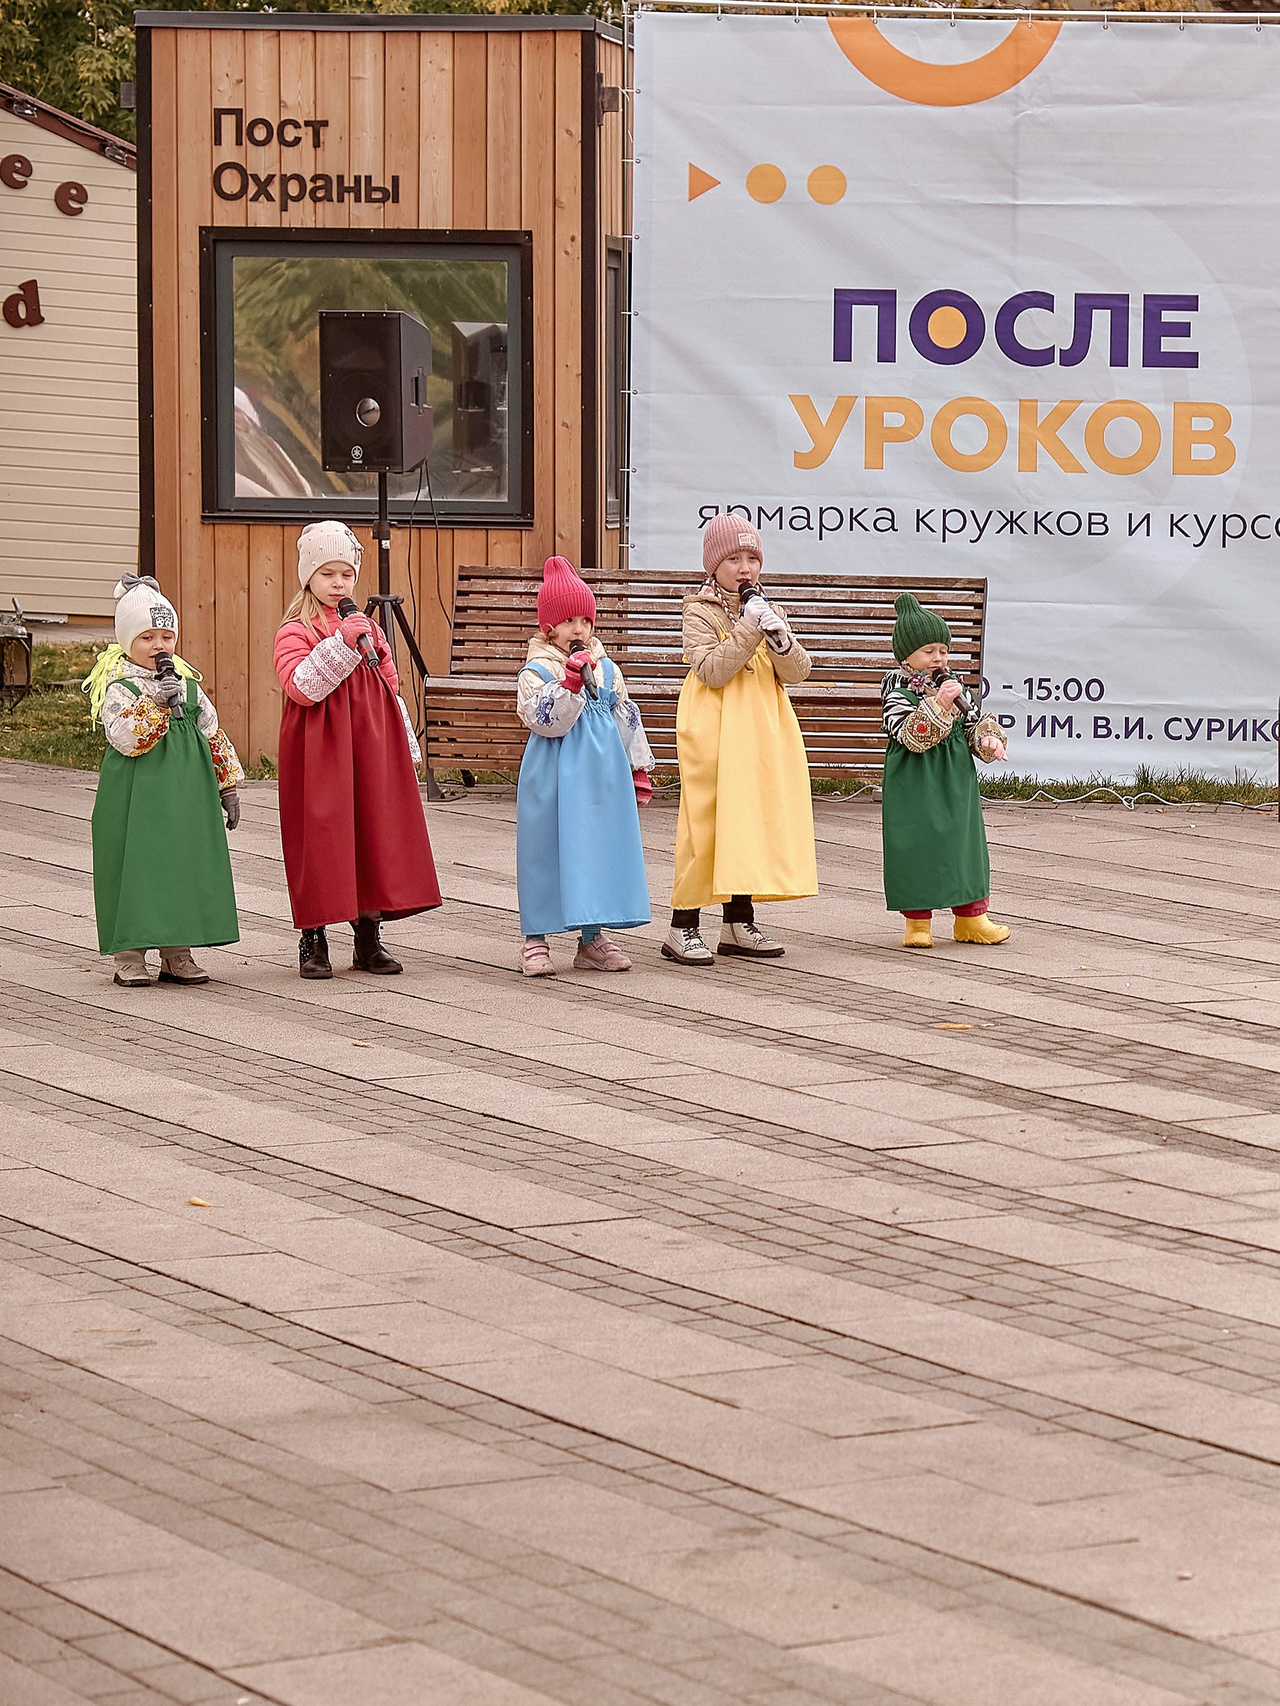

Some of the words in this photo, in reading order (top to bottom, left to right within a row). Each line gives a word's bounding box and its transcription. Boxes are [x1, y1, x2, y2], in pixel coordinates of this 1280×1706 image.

[212, 107, 329, 149] Пост
[212, 161, 400, 212] Охраны
[832, 287, 1200, 369] ПОСЛЕ
[788, 394, 1237, 476] УРОКОВ
[915, 507, 1110, 544] кружков
[1128, 512, 1151, 537] и
[1023, 677, 1105, 702] 15:00
[1026, 714, 1082, 739] ИМ.
[1093, 715, 1153, 741] В.И.
